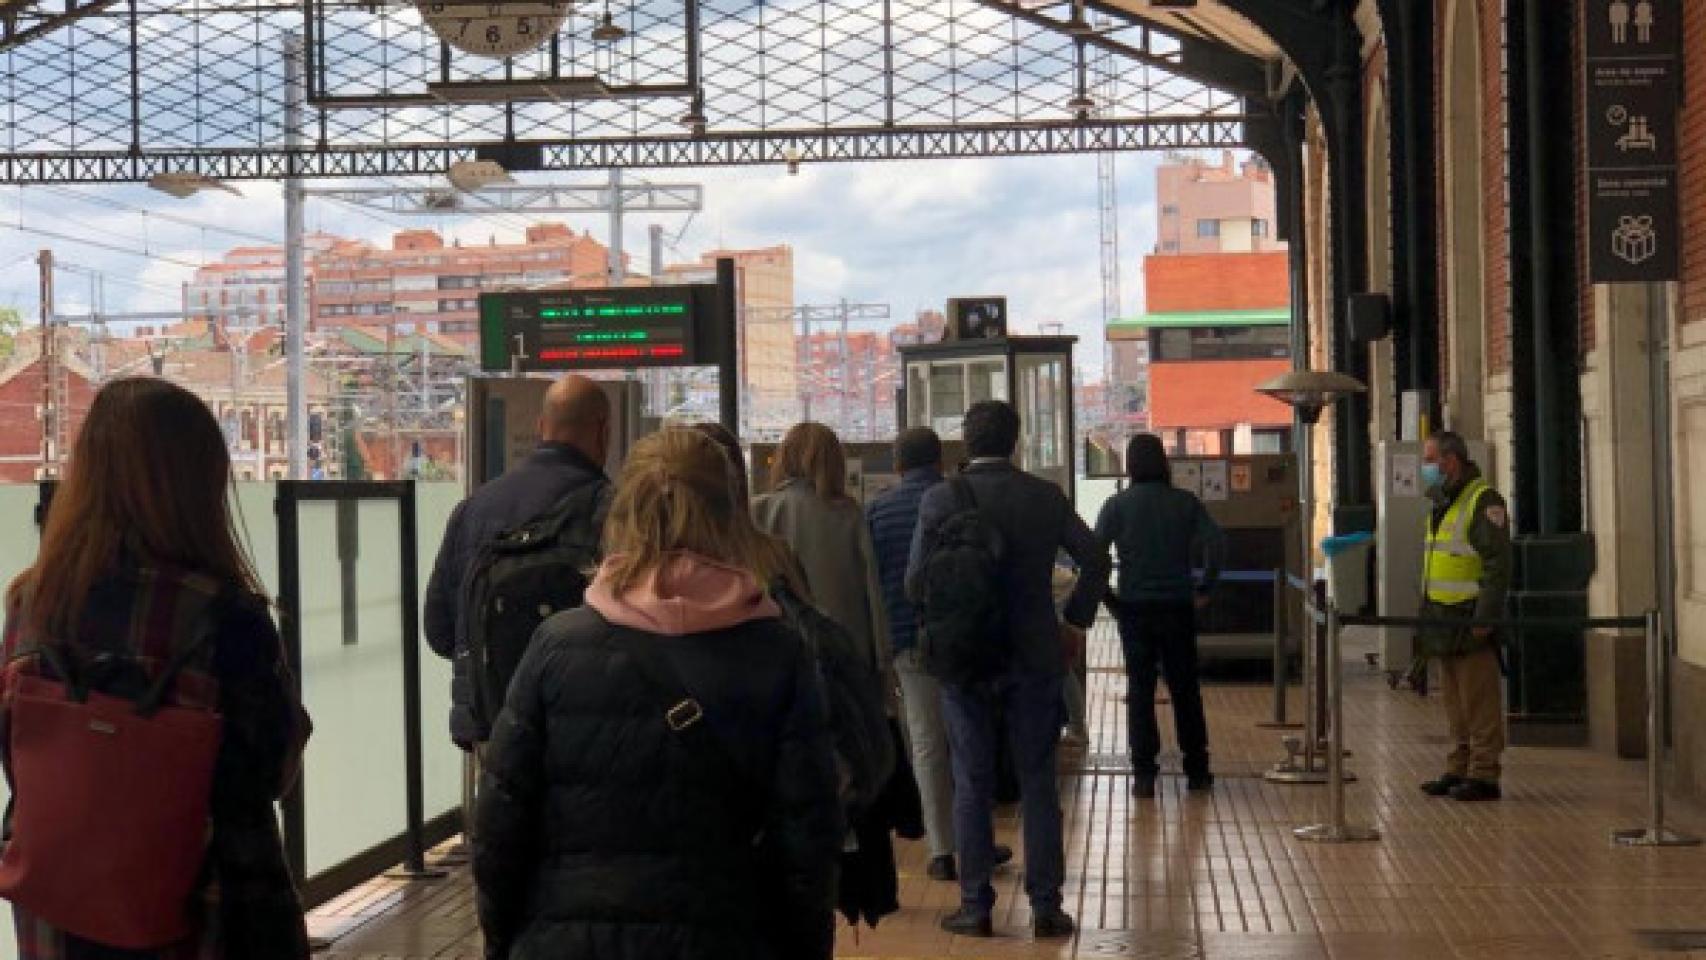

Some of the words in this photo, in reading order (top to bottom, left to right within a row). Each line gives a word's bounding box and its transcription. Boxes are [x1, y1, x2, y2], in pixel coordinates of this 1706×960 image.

[459, 17, 472, 37] 7
[486, 25, 500, 43] 6
[517, 17, 530, 35] 5
[513, 332, 528, 358] 1
